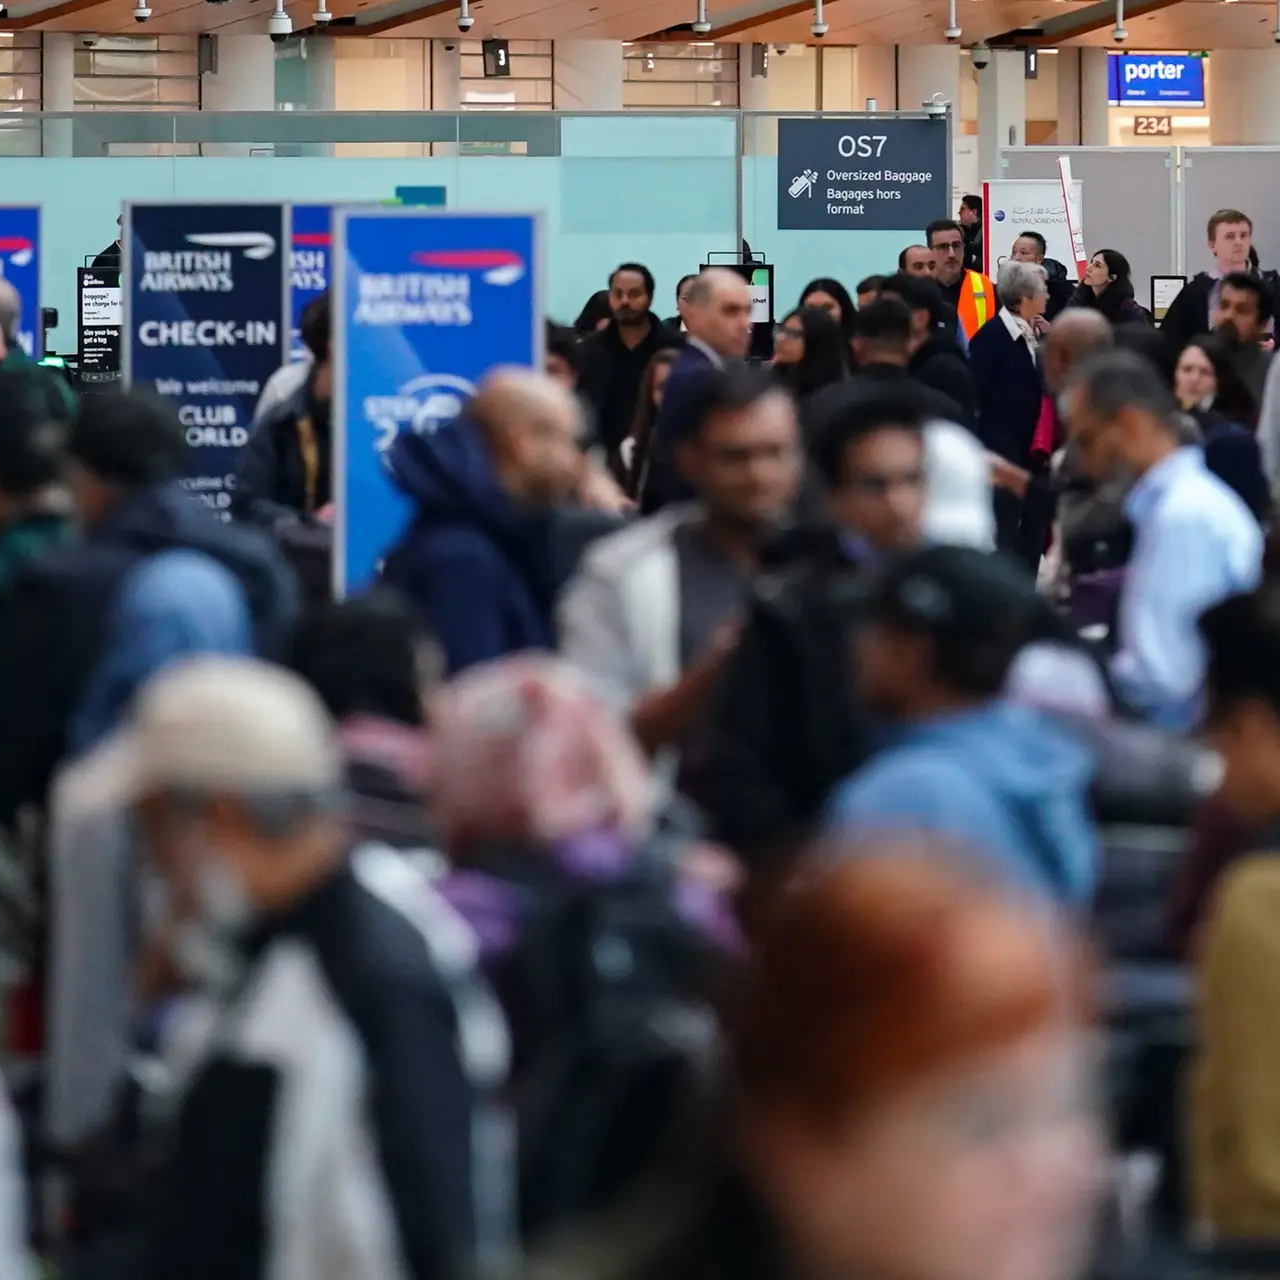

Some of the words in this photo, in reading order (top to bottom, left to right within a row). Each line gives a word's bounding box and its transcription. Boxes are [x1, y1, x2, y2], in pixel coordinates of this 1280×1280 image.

[498, 48, 506, 66] 3
[1124, 60, 1185, 83] porter
[1136, 117, 1170, 134] 234
[838, 135, 888, 157] OS7
[826, 170, 882, 181] Oversized
[884, 170, 933, 184] Baggage
[826, 188, 874, 201] Bagages
[877, 188, 902, 200] hors
[826, 203, 865, 215] format
[143, 251, 232, 271] BRITISH
[140, 272, 234, 292] AIRWAYS
[138, 321, 276, 346] CHECK-IN
[155, 377, 183, 395] We
[186, 377, 260, 395] welcome
[178, 405, 237, 426] CLUB
[185, 426, 249, 447] ORLD
